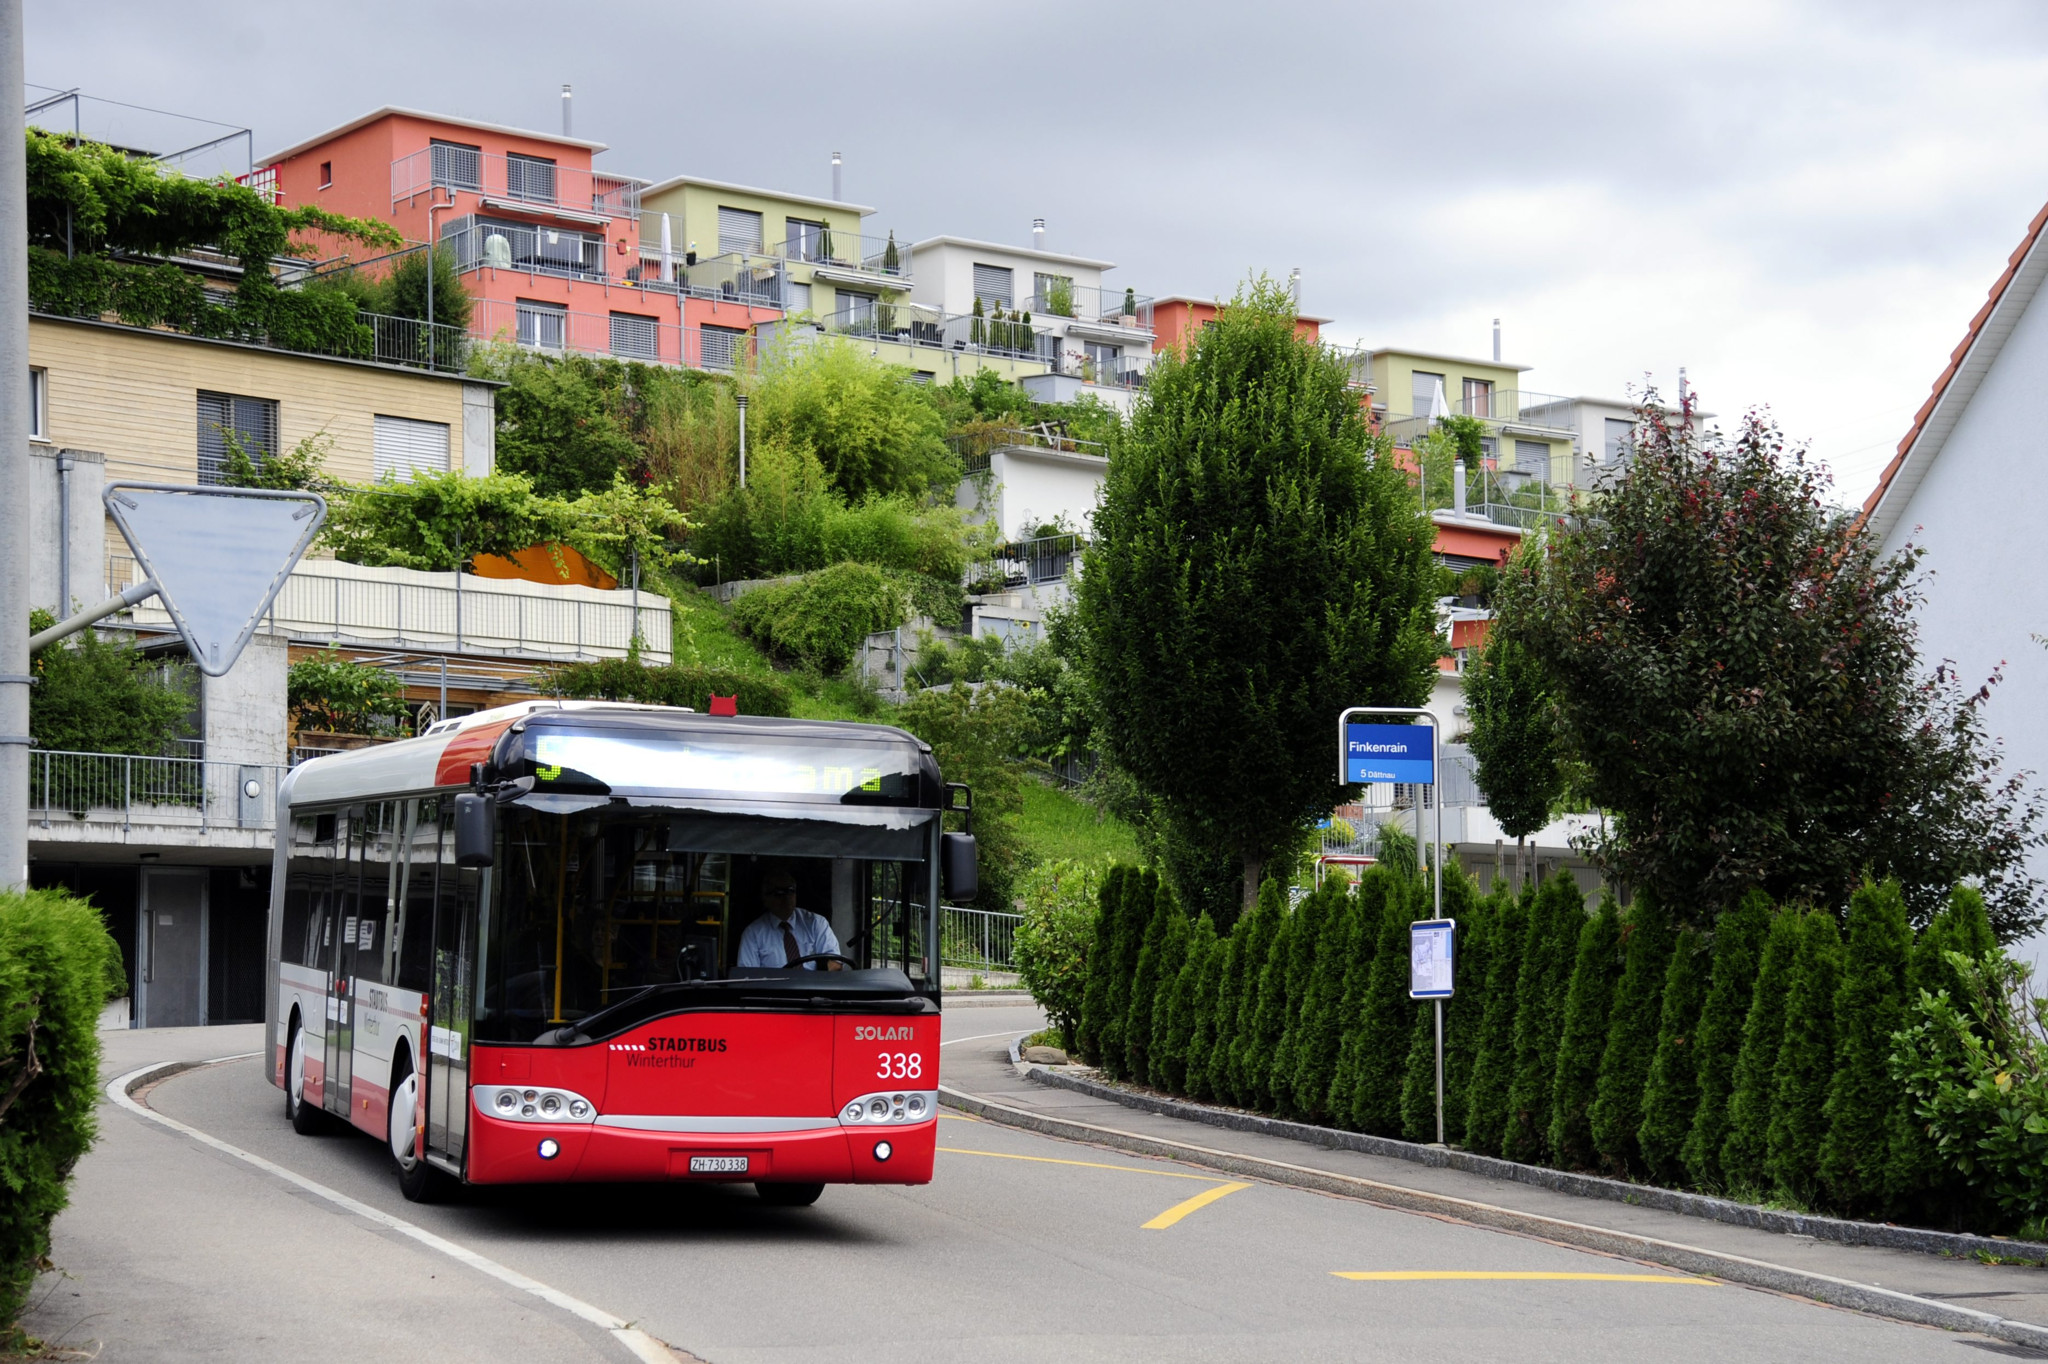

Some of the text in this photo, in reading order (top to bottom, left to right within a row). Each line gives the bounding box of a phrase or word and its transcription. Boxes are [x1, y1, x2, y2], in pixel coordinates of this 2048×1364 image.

[1349, 741, 1408, 753] Finkenrain
[1360, 768, 1396, 779] 5 Dättnau
[854, 1026, 914, 1041] SOLARI
[648, 1036, 728, 1053] STADTBUS
[626, 1053, 696, 1068] Winterthur
[876, 1052, 922, 1079] 338
[728, 1159, 746, 1171] 338
